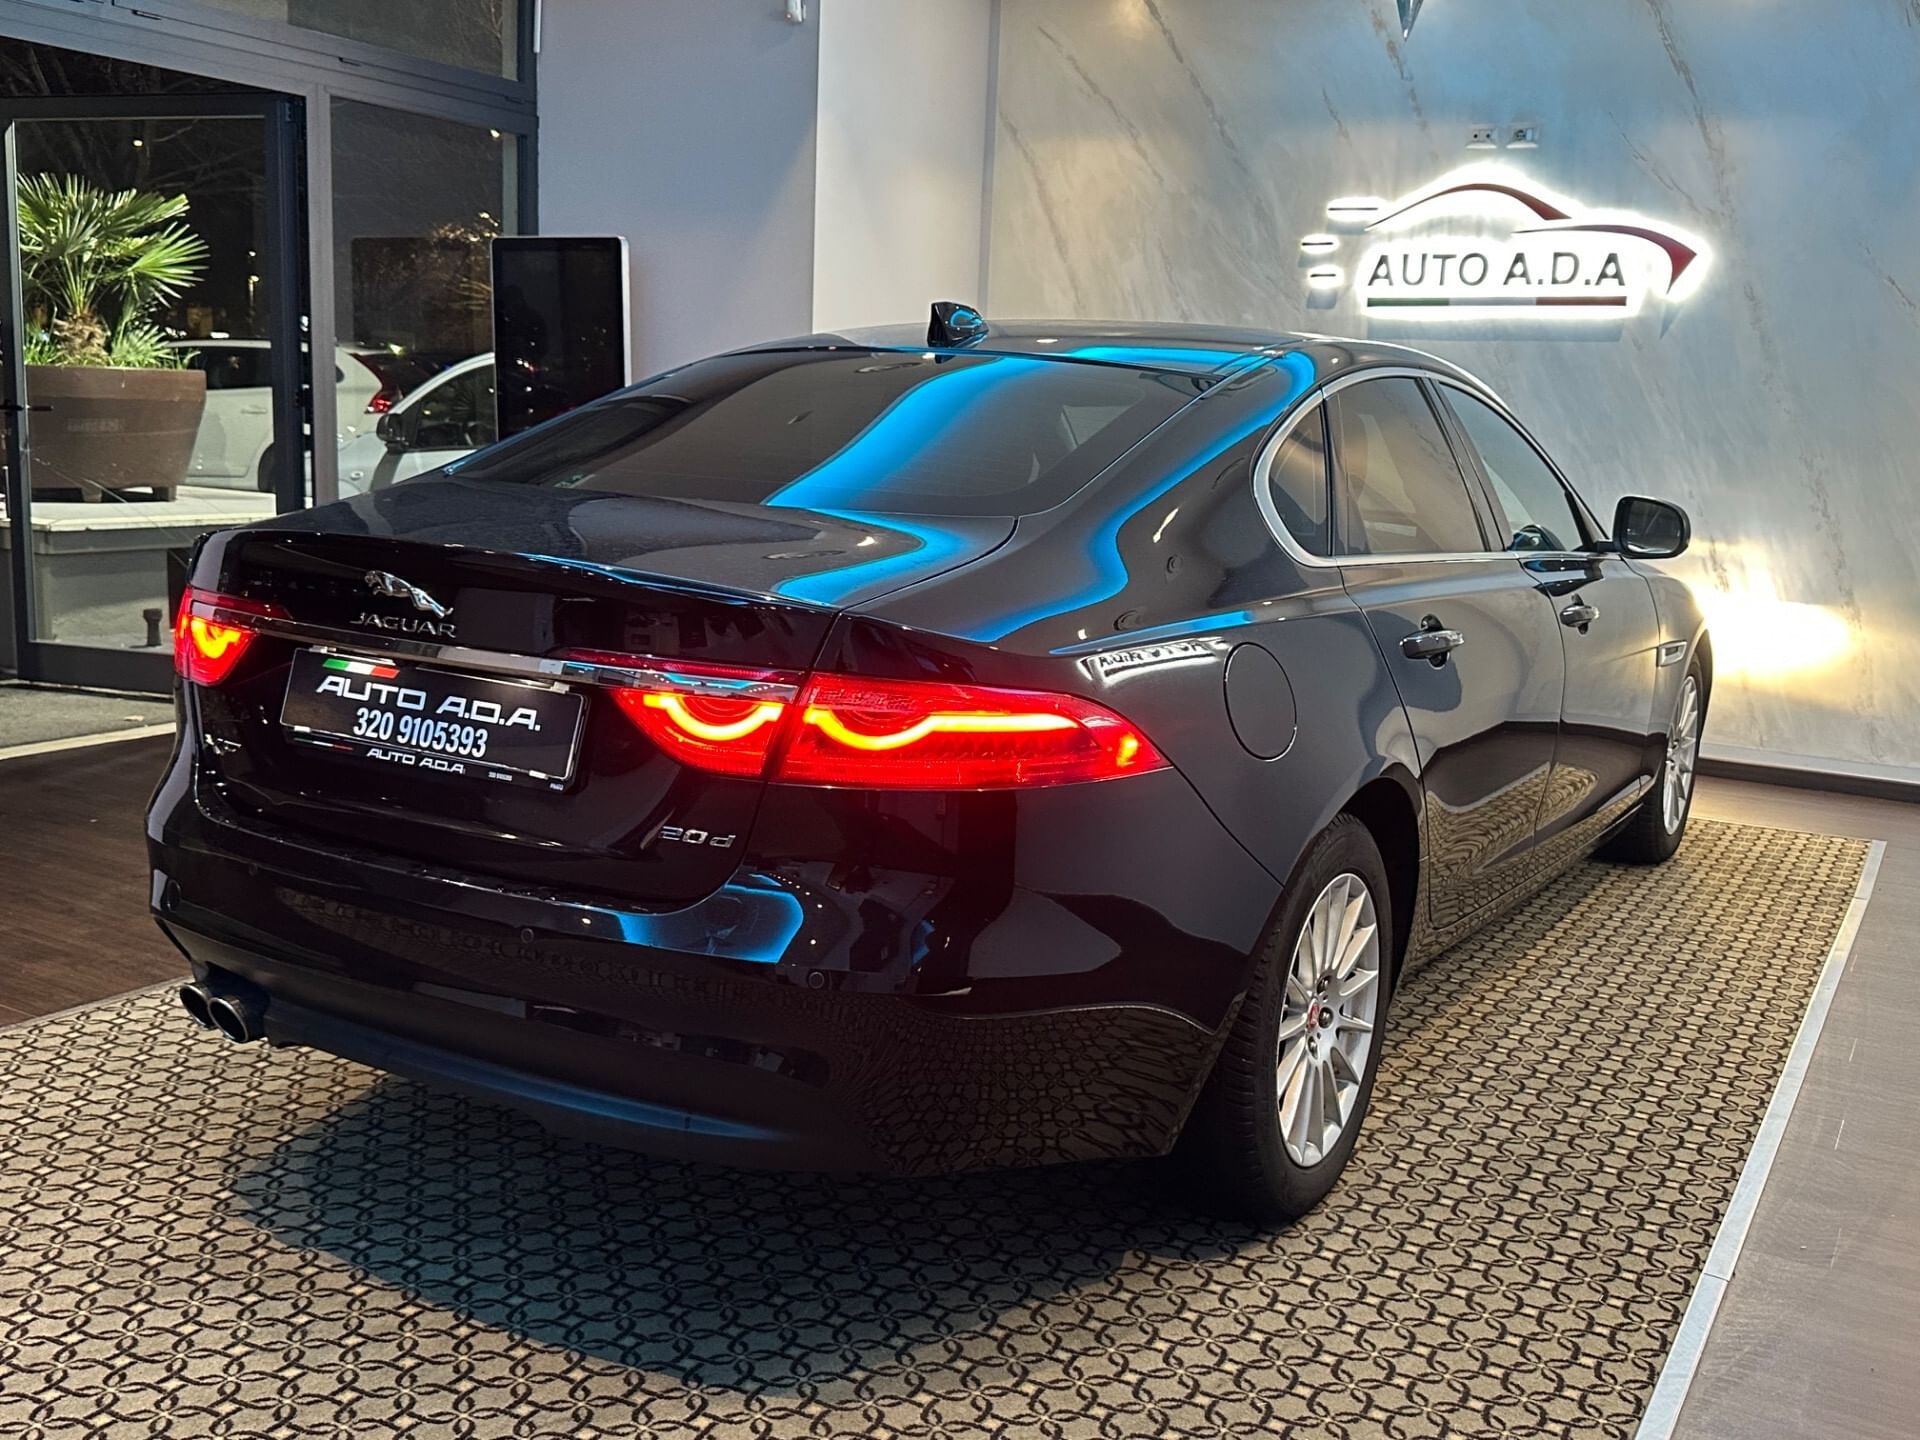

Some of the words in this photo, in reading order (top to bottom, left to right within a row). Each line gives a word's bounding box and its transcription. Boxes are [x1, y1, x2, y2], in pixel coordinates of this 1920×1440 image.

[1368, 252, 1488, 286] AUTO
[1503, 252, 1626, 286] A.D.A
[350, 612, 457, 638] JAGUAR
[316, 675, 426, 711] AUTO
[435, 695, 541, 731] A.D.A.
[353, 707, 394, 741] 320
[397, 715, 489, 758] 9105393
[366, 748, 416, 765] AUTO
